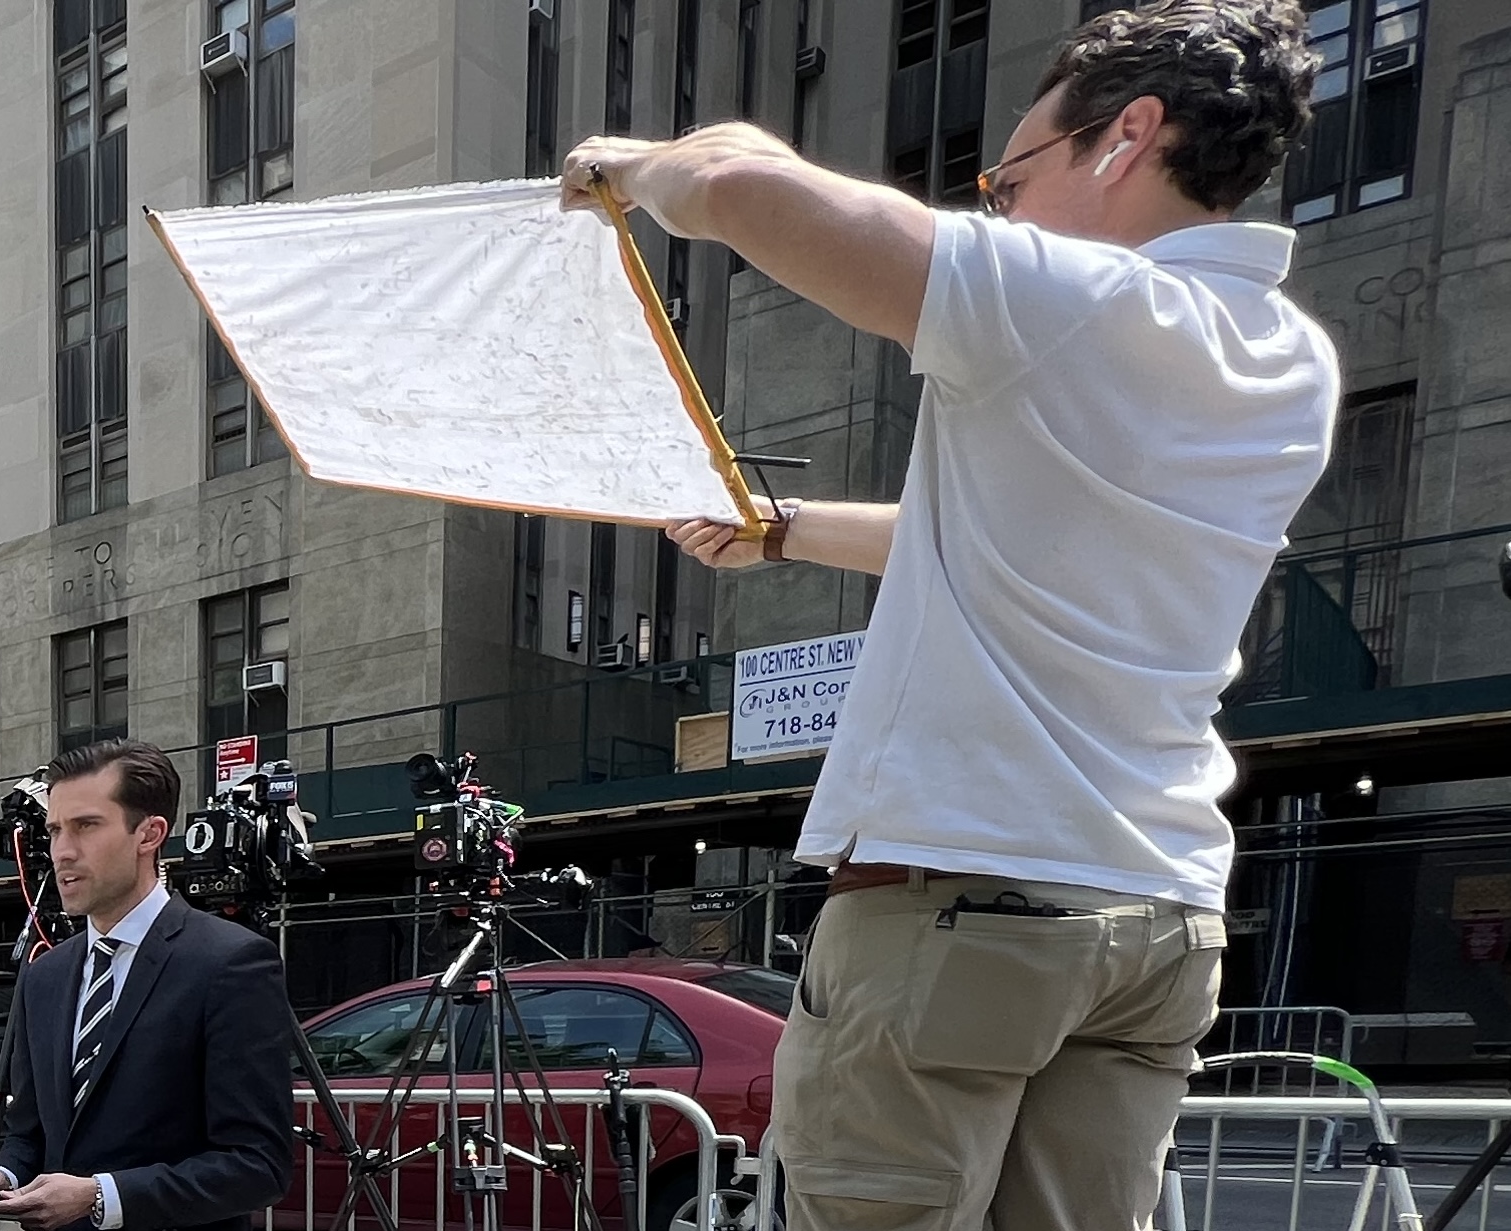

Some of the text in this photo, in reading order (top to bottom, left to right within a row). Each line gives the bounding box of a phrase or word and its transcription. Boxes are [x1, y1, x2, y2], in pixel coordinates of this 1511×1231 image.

[74, 540, 114, 570] TO
[740, 656, 757, 680] 100
[760, 646, 805, 675] CENTRE
[808, 643, 825, 668] ST.
[828, 638, 855, 664] NEW
[765, 684, 806, 705] J&N
